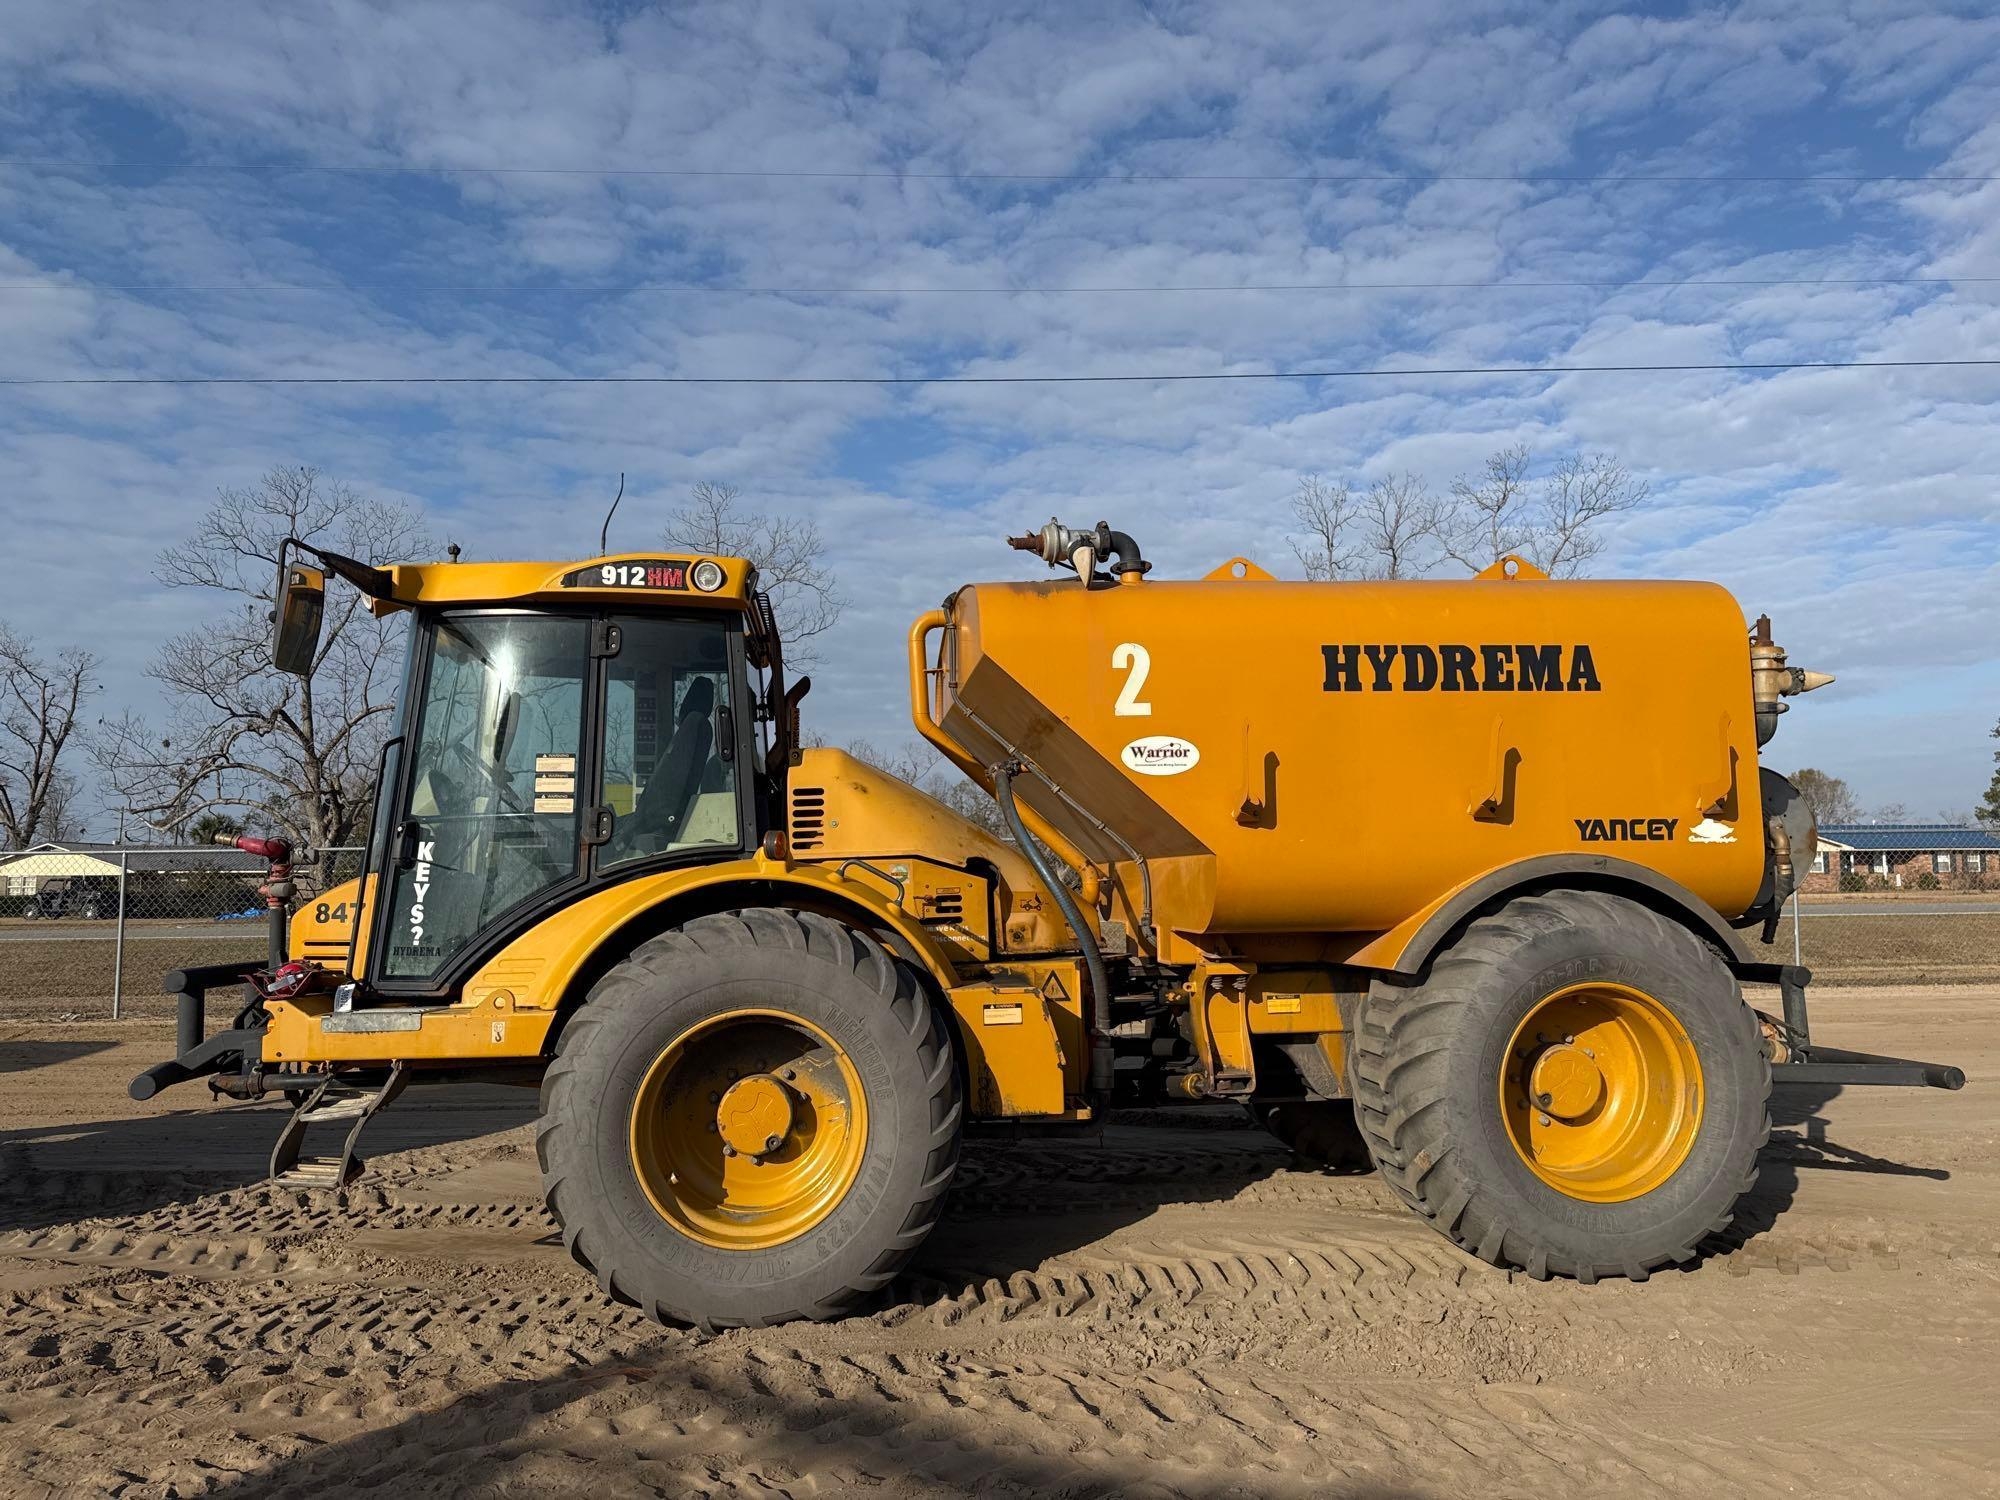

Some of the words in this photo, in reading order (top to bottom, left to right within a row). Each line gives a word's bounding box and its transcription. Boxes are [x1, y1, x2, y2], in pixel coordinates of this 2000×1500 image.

[1111, 642, 1152, 716] 2
[1320, 645, 1602, 692] HYDREMA
[1130, 745, 1190, 759] Warrior
[1573, 818, 1679, 841] YANCEY
[409, 841, 435, 946] KEYS?
[392, 946, 441, 957] HYDREMA
[824, 1007, 894, 1100] TRELLEBORG
